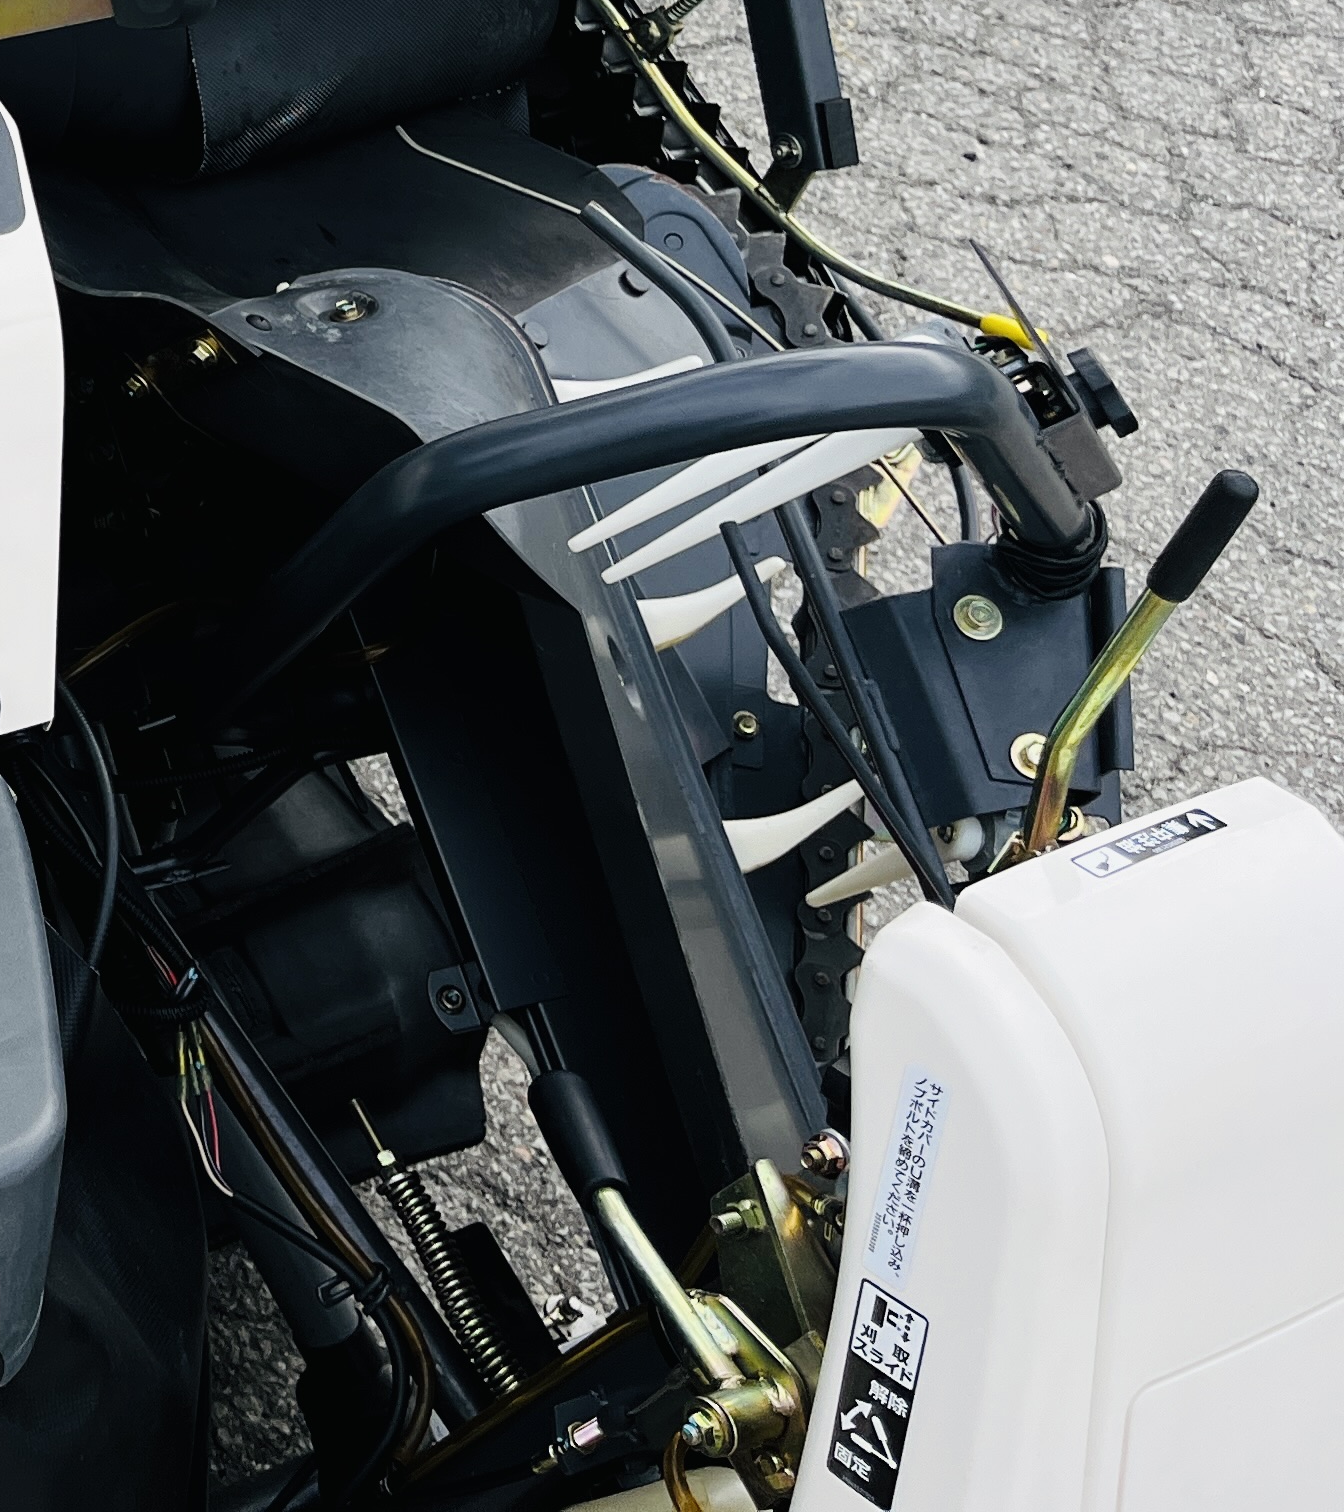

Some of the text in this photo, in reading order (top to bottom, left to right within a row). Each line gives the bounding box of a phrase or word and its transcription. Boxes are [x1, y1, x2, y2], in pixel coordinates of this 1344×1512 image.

[853, 1336, 914, 1384] スライド
[861, 1323, 911, 1365] 刈取
[868, 1379, 909, 1418] 解除
[834, 1441, 872, 1483] 固定
